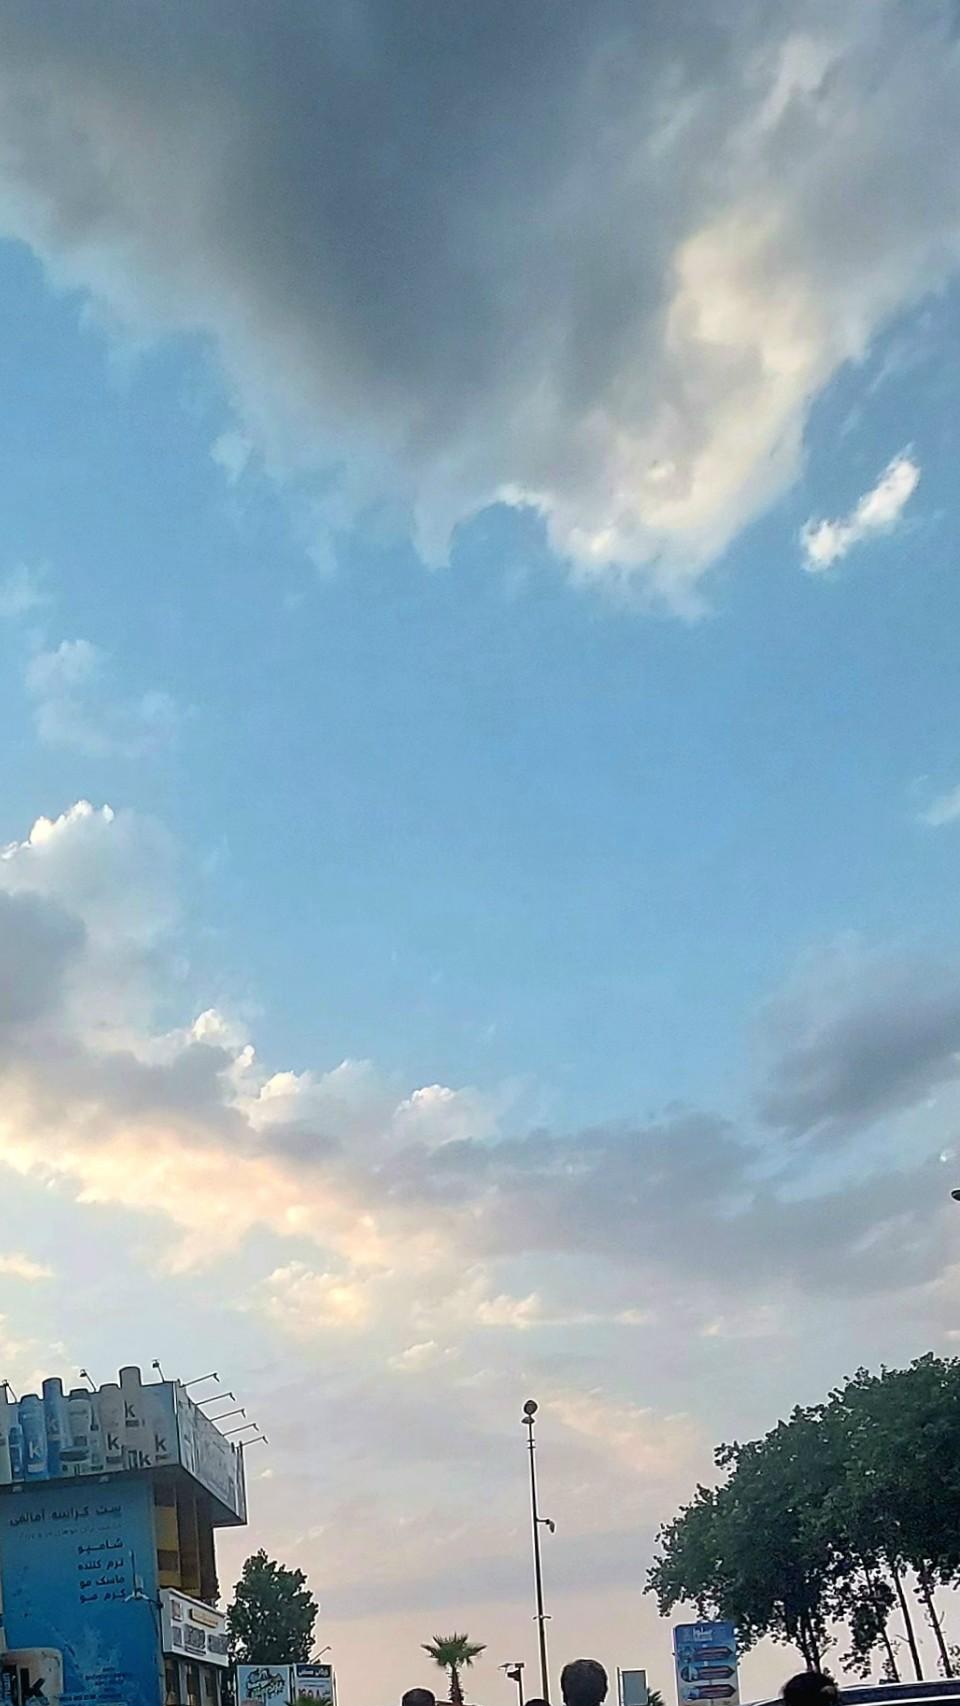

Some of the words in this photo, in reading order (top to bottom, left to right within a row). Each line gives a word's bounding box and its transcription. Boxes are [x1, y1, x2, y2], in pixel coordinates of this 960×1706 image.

[78, 1538, 123, 1555] شامپو
[79, 1579, 92, 1589] مو
[96, 1574, 125, 1587] ماسک
